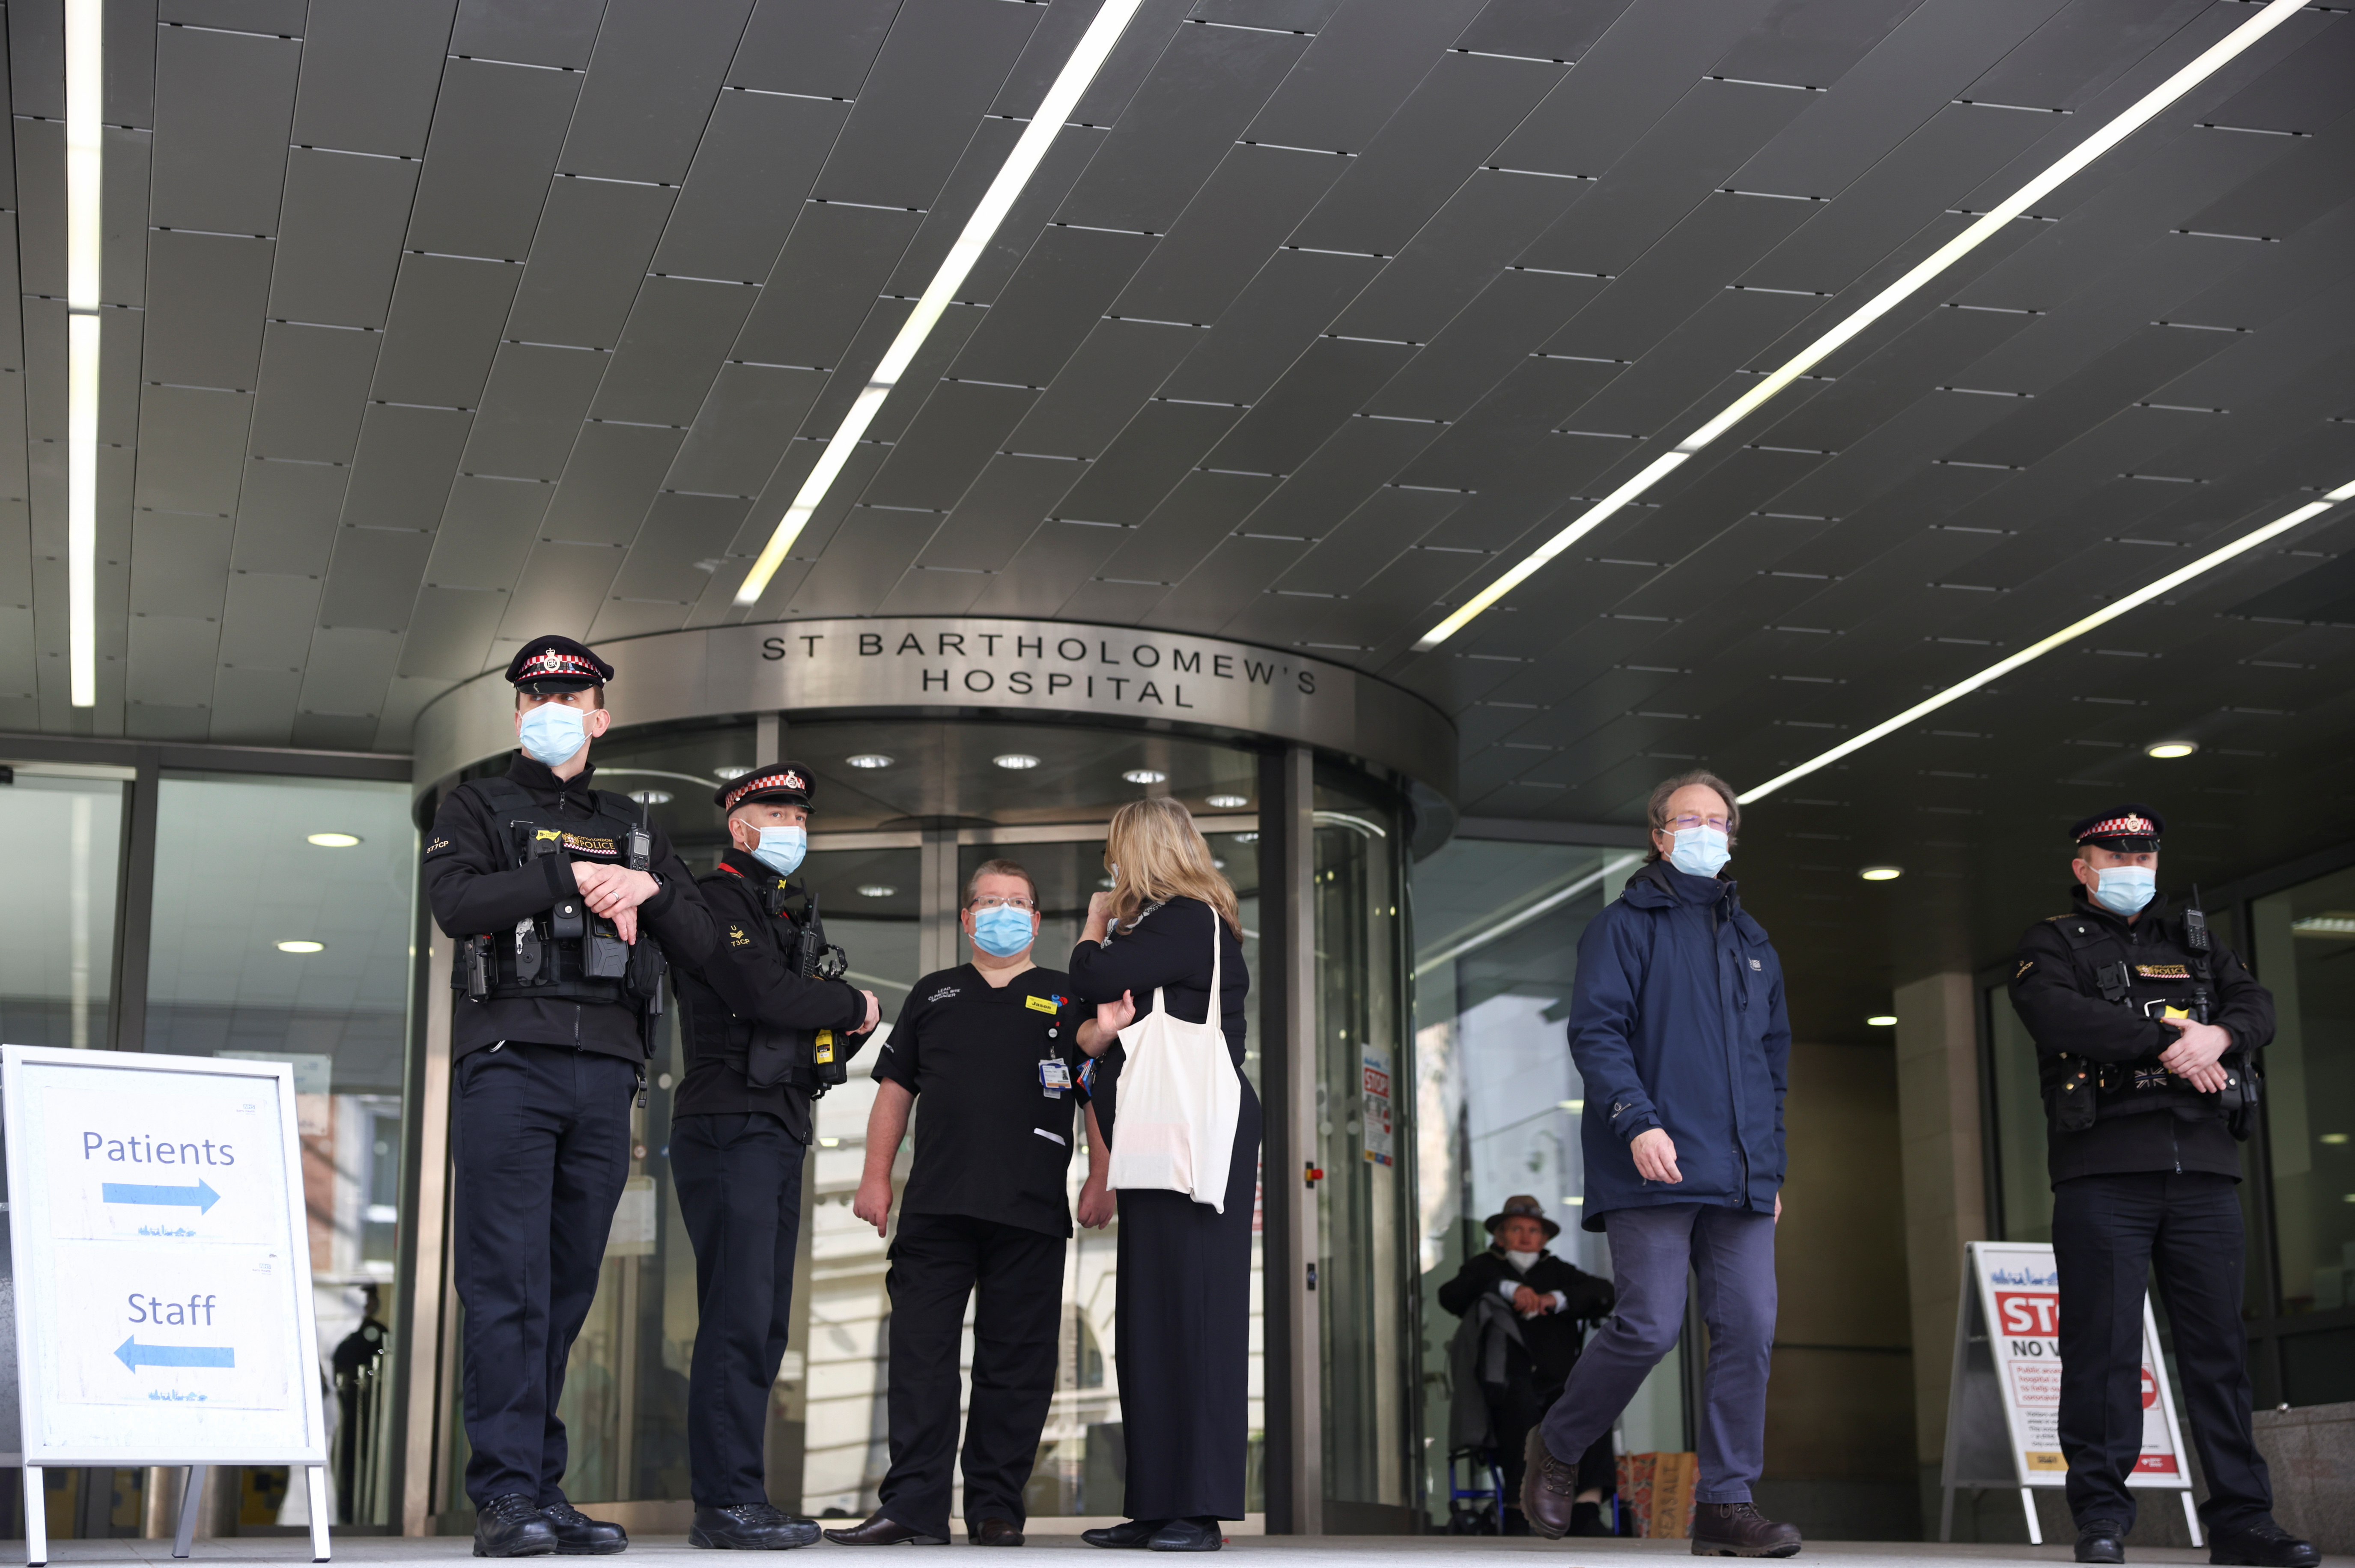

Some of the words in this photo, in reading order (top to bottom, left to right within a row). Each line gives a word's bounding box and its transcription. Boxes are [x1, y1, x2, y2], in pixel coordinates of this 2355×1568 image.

[762, 635, 824, 661] ST
[859, 632, 1316, 695] BARTHOLOMEW'S
[922, 669, 1193, 708] HOSPITAL
[579, 840, 615, 850] POLICE
[730, 938, 750, 947] 73CP
[928, 990, 949, 1001] CLINICAL
[931, 993, 956, 1002] MANAGER
[1031, 1002, 1052, 1010] Jason
[83, 1131, 235, 1166] Patients
[128, 1293, 216, 1326] Staff
[2003, 1296, 2060, 1333] ST
[2012, 1341, 2043, 1356] NO
